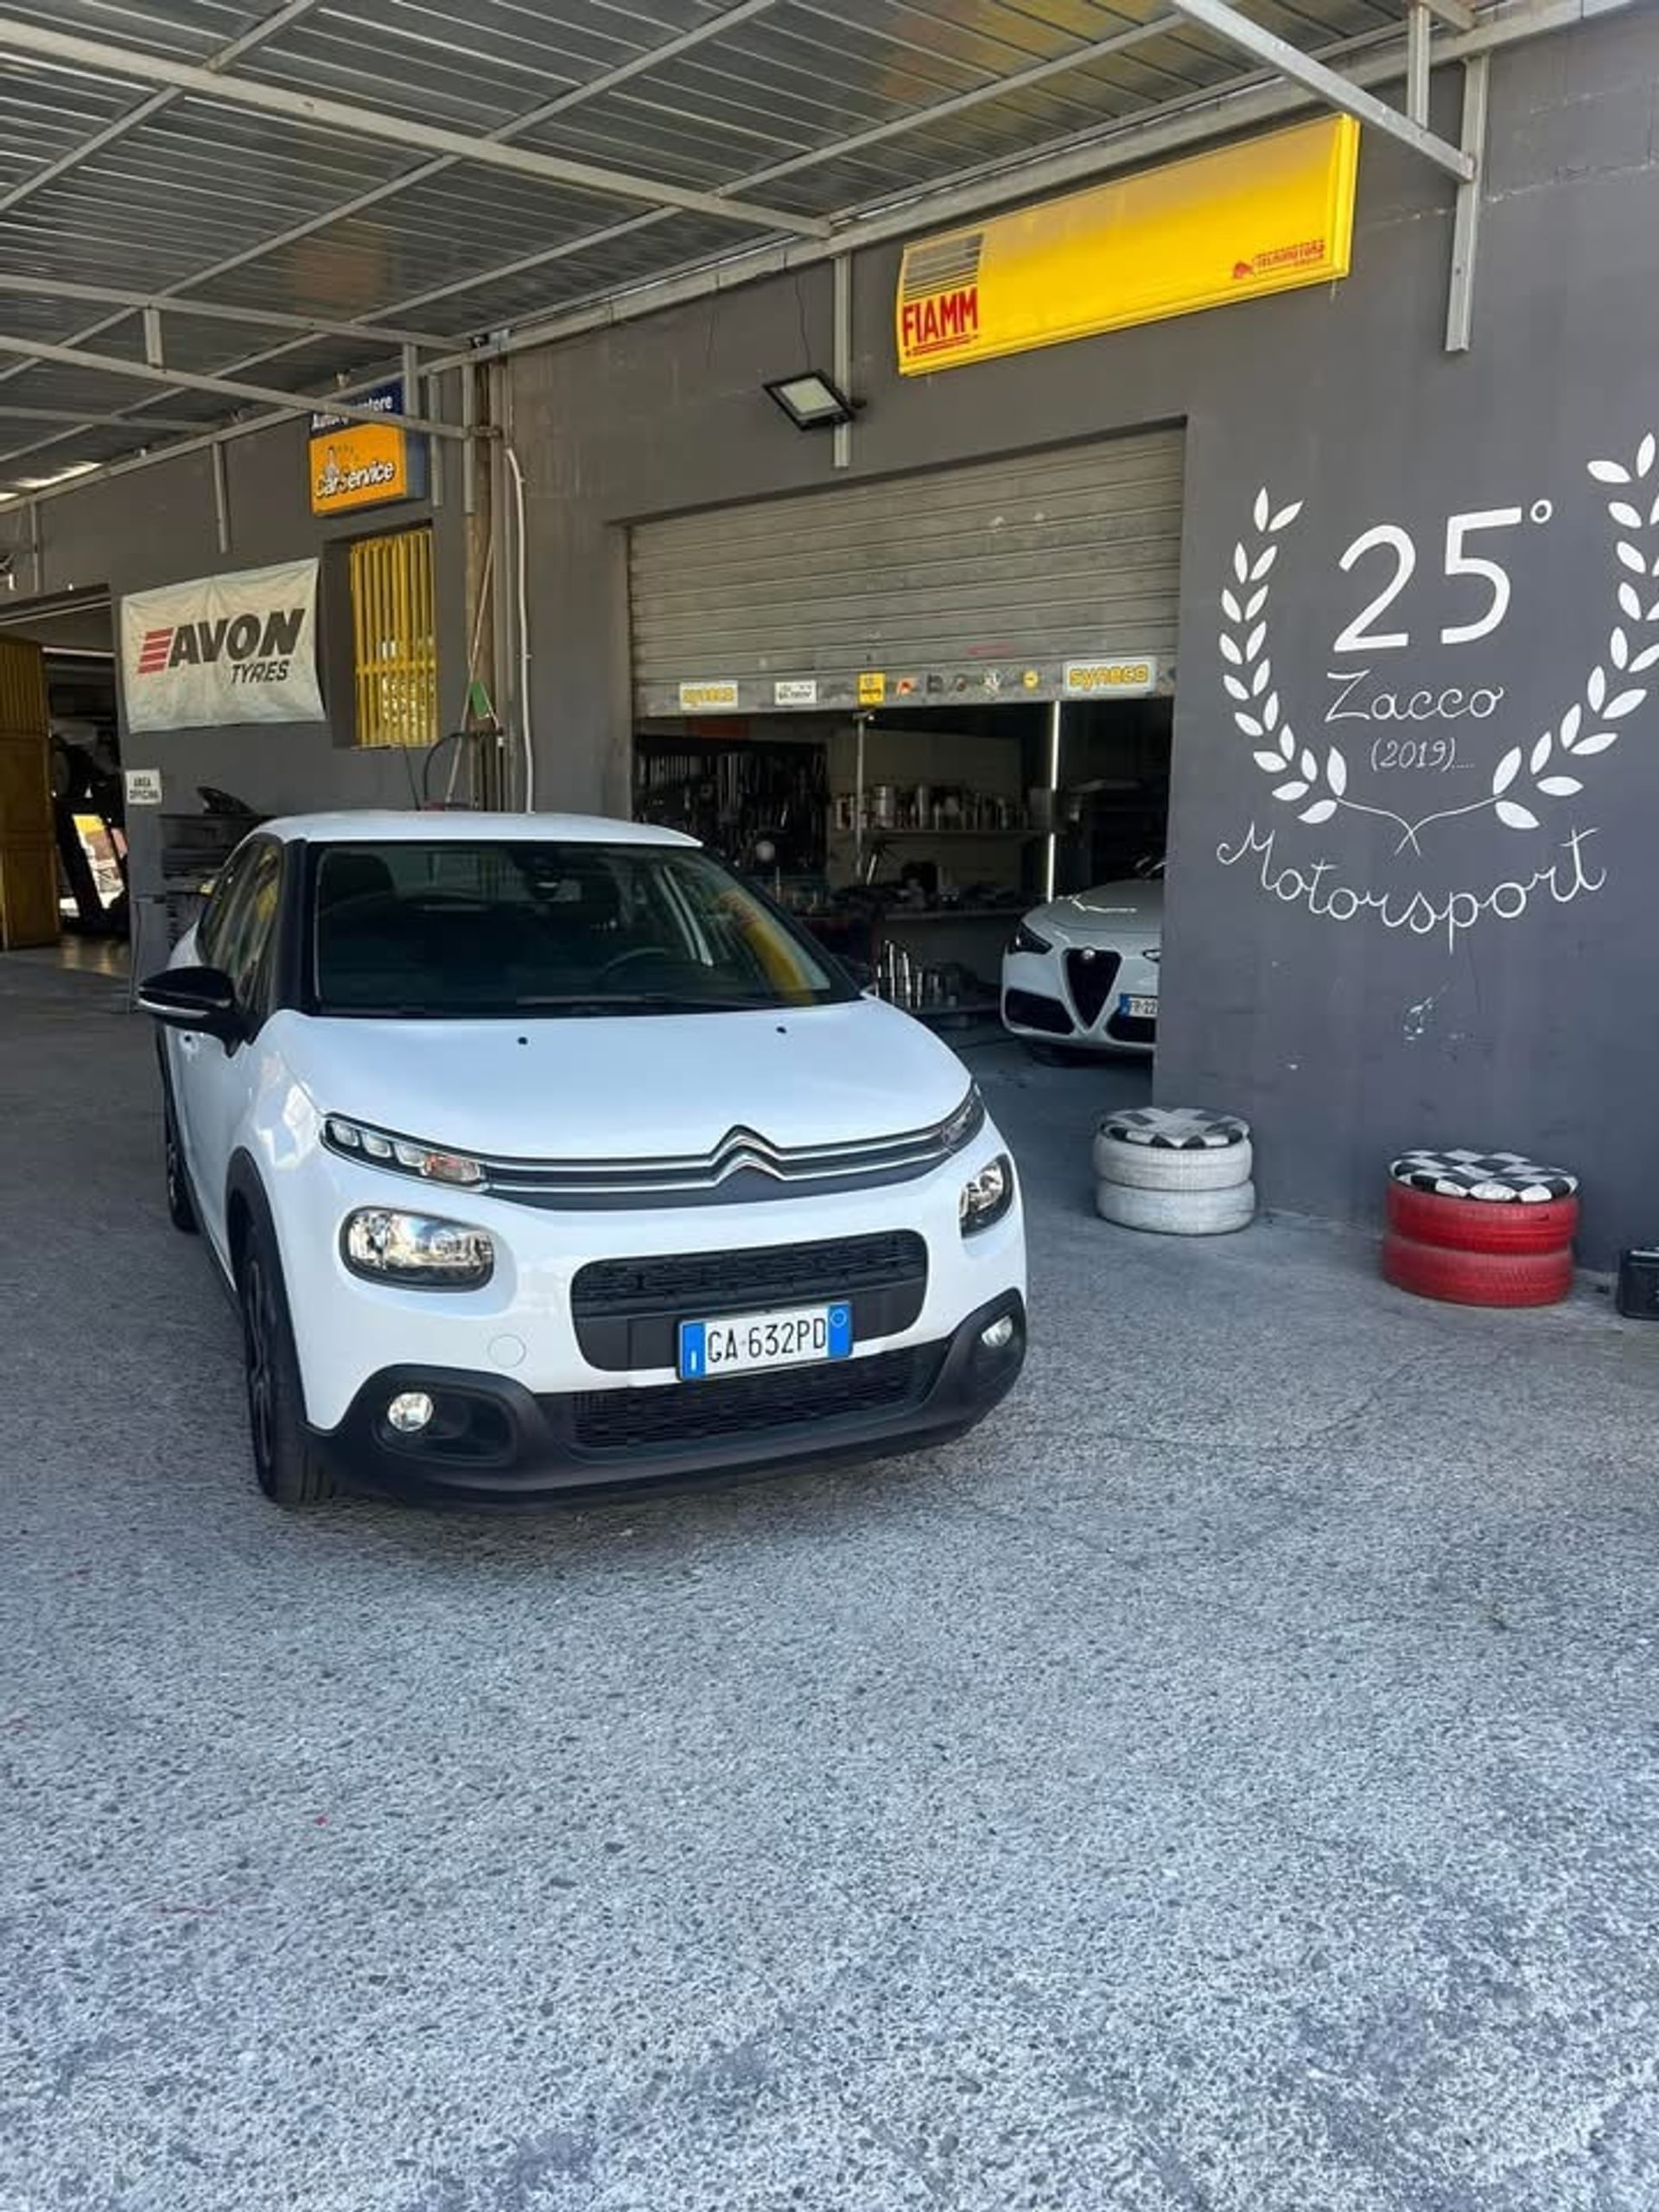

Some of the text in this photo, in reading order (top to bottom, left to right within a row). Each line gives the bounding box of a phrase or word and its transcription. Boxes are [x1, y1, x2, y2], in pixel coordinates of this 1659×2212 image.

[903, 286, 978, 347] FIAMM
[168, 608, 306, 667] AVON
[232, 659, 289, 684] TYRES
[1325, 669, 1504, 723] Zacco
[1216, 821, 1607, 954] Motorsport
